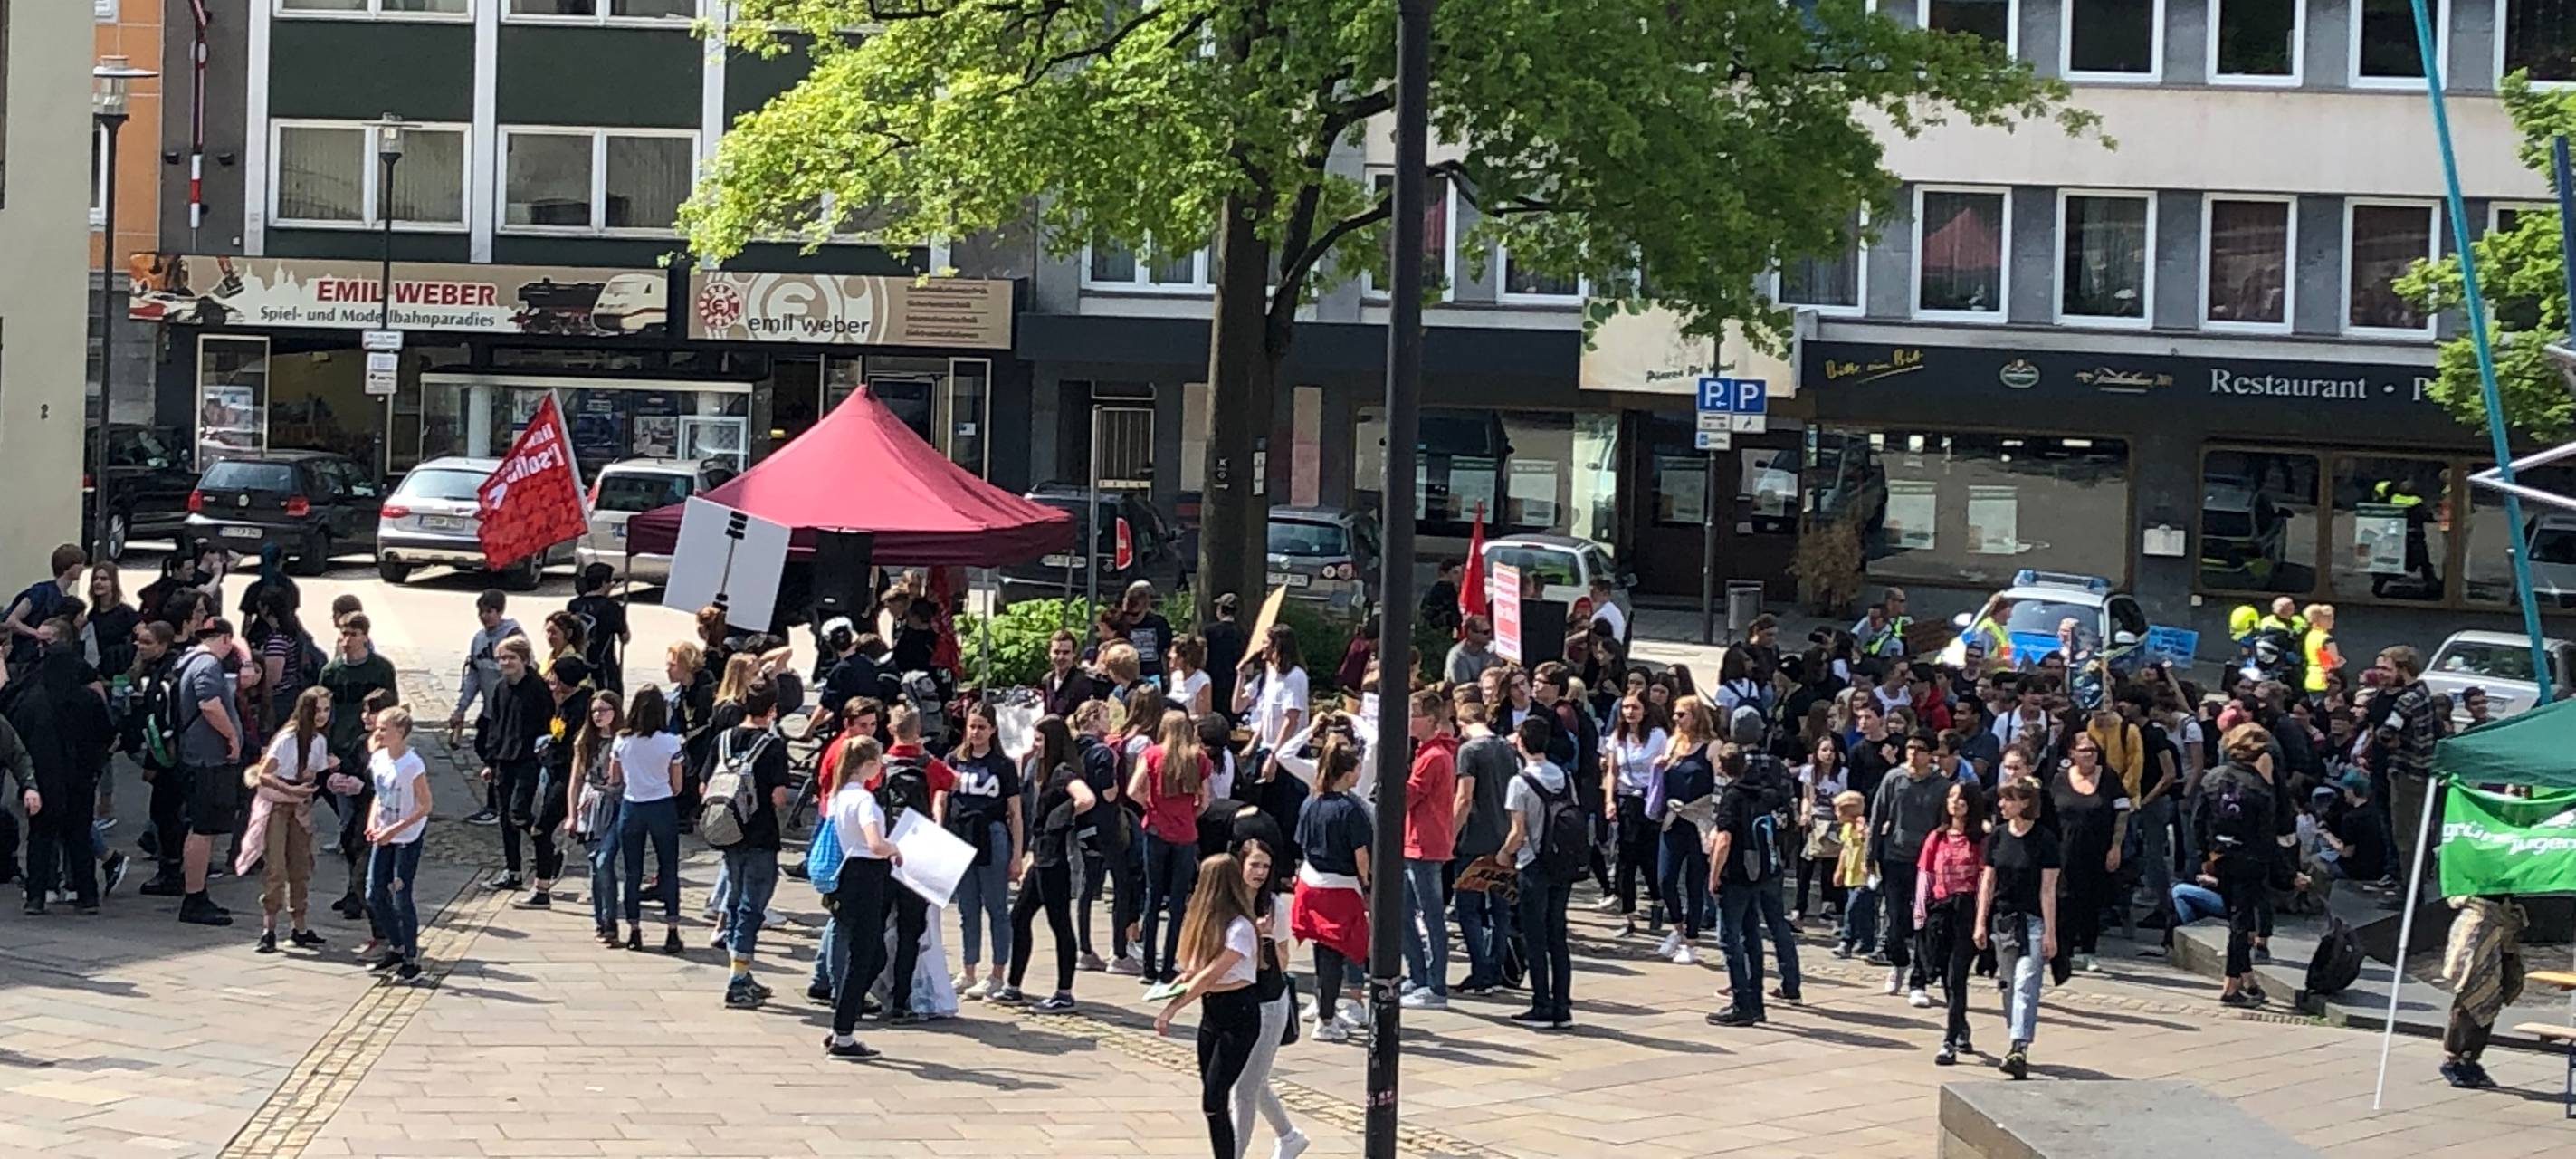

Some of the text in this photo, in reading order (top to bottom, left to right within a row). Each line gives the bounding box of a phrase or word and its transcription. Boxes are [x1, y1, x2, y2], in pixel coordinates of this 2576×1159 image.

[317, 281, 496, 306] EMIL WEBER
[260, 306, 496, 328] Spiel- und Modelbahnparadies
[748, 314, 871, 335] emil weber
[1704, 380, 1725, 407] P
[1739, 383, 1760, 409] P
[2209, 369, 2432, 401] Restaurant P
[959, 771, 1000, 799] ILA
[2508, 837, 2576, 856] jugen
